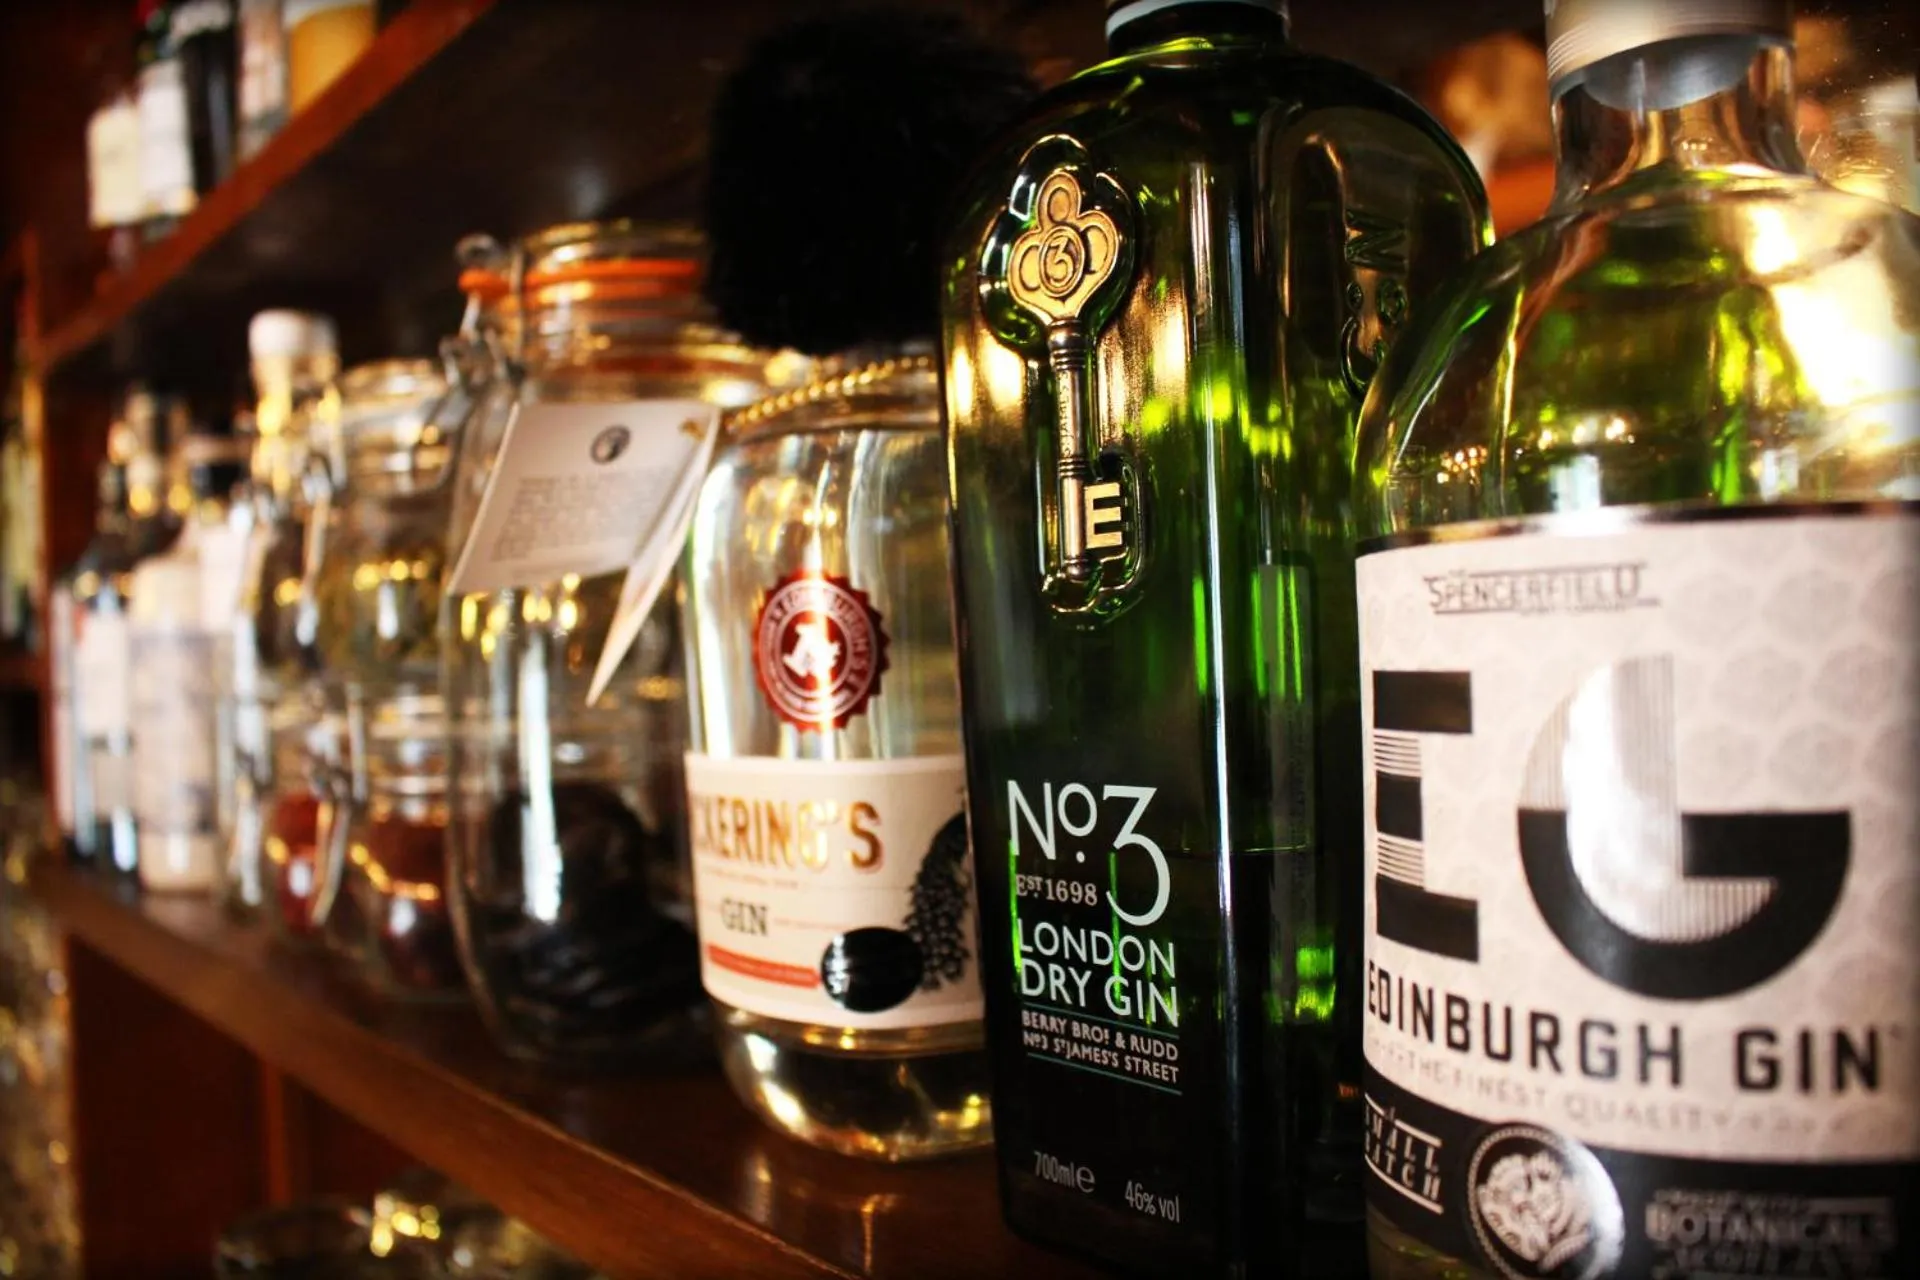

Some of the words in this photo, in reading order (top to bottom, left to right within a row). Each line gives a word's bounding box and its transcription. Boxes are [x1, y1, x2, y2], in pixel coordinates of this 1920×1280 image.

[1044, 235, 1077, 287] 3
[721, 898, 768, 936] GIN
[1017, 917, 1176, 979] LONDON
[1020, 957, 1092, 1008] DRY
[1104, 975, 1178, 1028] GIN
[1021, 1010, 1068, 1035] BERRY
[1115, 1031, 1126, 1049] &
[1130, 1034, 1179, 1062] RUDD
[1369, 959, 1683, 1087] EDINBURGH
[1735, 1028, 1880, 1093] GIN
[1124, 1054, 1180, 1084] STREET
[1124, 1179, 1157, 1216] 46%
[1158, 1195, 1180, 1224] vol
